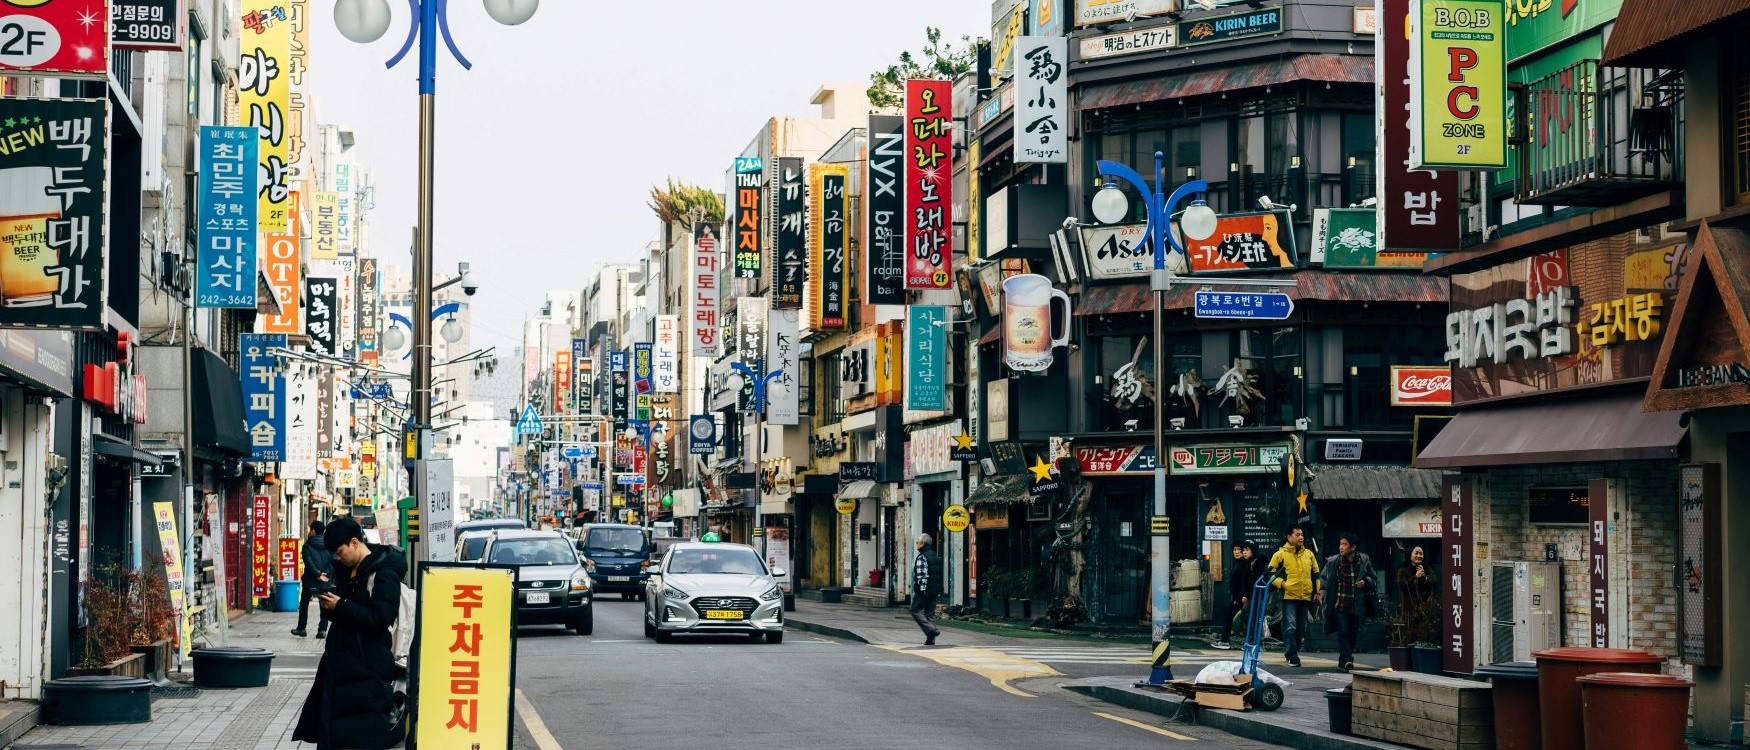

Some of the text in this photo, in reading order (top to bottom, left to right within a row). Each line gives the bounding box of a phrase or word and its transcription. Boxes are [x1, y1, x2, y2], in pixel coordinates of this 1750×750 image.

[1215, 17, 1247, 32] KIRIN
[1249, 12, 1277, 27] BEER
[1434, 7, 1491, 28] B.O.B
[1, 22, 47, 56] 2F
[1447, 47, 1479, 121] PC
[239, 47, 289, 205] 야시장
[1442, 123, 1485, 138] ZONE
[737, 159, 762, 172] 24시
[1457, 145, 1471, 155] 2F
[211, 143, 244, 200] 최민주
[736, 174, 761, 187] THAI
[911, 88, 947, 267] 오페라 노래방
[870, 132, 903, 250] Nyx bar
[44, 116, 93, 309] 백두대간
[206, 218, 249, 231] 스포츠
[213, 203, 244, 217] 경락
[270, 209, 284, 220] 2F
[738, 188, 759, 251] 마사지
[779, 166, 802, 282] 뉴캐슬
[824, 179, 844, 274] 해금강
[14, 224, 33, 232] NEW
[315, 205, 335, 252] 부동산
[1120, 227, 1142, 236] DRY
[14, 245, 41, 255] BEER
[210, 236, 246, 292] 마사지
[873, 265, 902, 276] room
[935, 273, 946, 283] 2F
[200, 294, 253, 305] 242-3642
[696, 238, 717, 344] 토마토노래방
[877, 284, 896, 296] bar
[1444, 286, 1664, 369] 돼지국밥 감자탕
[249, 365, 283, 447] 커피숍
[1032, 482, 1059, 493] SAPPORO
[254, 499, 267, 539] 쓰리스타
[254, 541, 267, 584] 노래방
[446, 585, 484, 733] 주차금지
